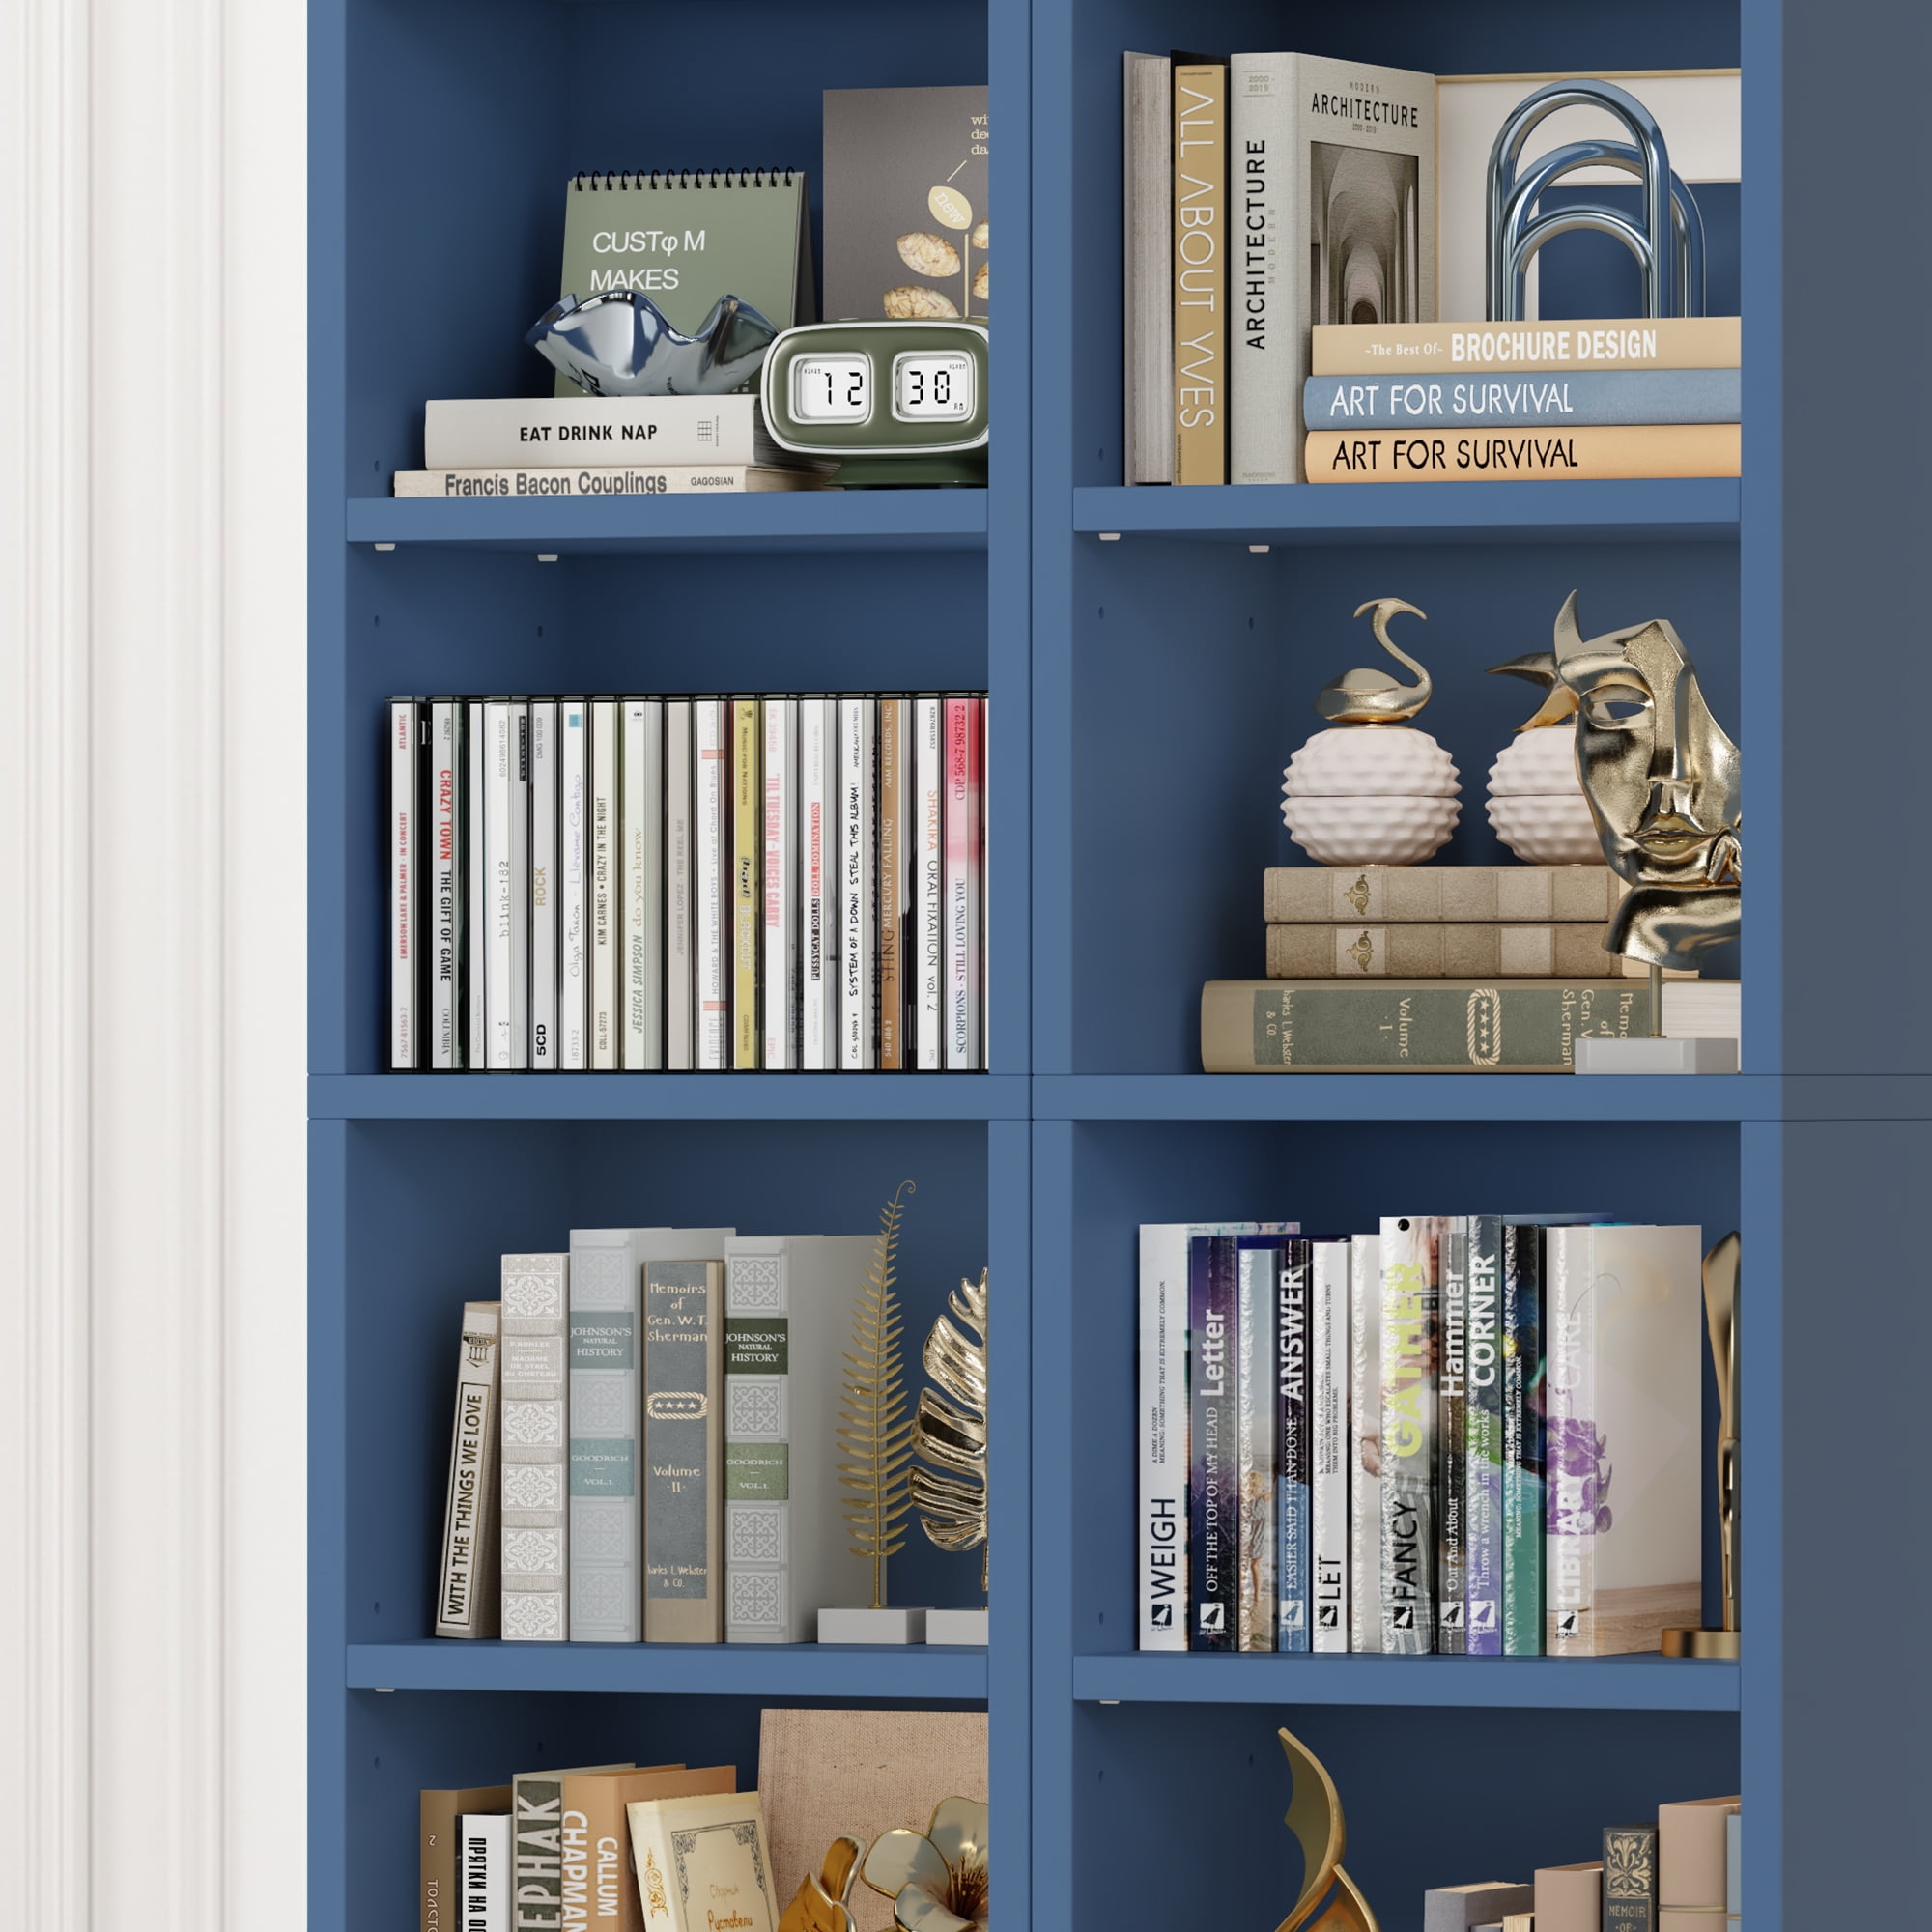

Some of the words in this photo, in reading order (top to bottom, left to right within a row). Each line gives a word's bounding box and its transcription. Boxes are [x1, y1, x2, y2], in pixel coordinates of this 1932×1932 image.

[1179, 86, 1215, 158] ALL
[1311, 92, 1419, 128] ARCHITECTURE
[934, 192, 966, 223] new
[1179, 173, 1215, 313] ABOUT
[1246, 140, 1266, 350] ARCHITECTURE
[1267, 209, 1276, 285] MODERN
[590, 268, 680, 291] MAKES
[1395, 342, 1420, 355] Best
[1451, 331, 1571, 361] BROCHURE
[1577, 329, 1657, 360] DESIGN
[824, 372, 863, 406] 12
[908, 370, 951, 405] 30
[1179, 330, 1215, 428] YVES
[1329, 385, 1379, 416] ART
[1390, 384, 1443, 416] FOR
[1452, 383, 1574, 415] SURVIVAL
[520, 427, 552, 441] EAT
[558, 425, 613, 440] DRINK
[621, 424, 658, 440] NAP
[1332, 440, 1381, 470] ART
[1393, 440, 1446, 469] FOR
[1456, 439, 1578, 469] SURVIVAL
[445, 473, 509, 496] Francis
[516, 472, 571, 496] Bacon
[578, 471, 667, 495] Couplings
[691, 477, 734, 487] GAGOSIAN
[954, 715, 966, 745] 98732
[709, 765, 718, 788] Blues
[954, 749, 966, 777] 568-7
[440, 770, 452, 814] CRAZY
[954, 778, 966, 801] CDP
[596, 797, 606, 821] NIGHT
[709, 806, 718, 834] Chord
[927, 790, 938, 850] SHAKIRA
[440, 821, 452, 861] TOWN
[596, 824, 606, 839] THE
[596, 843, 606, 852] IN
[811, 802, 820, 867] DOMINATION
[849, 824, 859, 848] THIS
[883, 819, 893, 867] FALLING
[399, 847, 407, 856] IN
[632, 828, 642, 870] know
[709, 845, 718, 865] Live
[440, 869, 451, 894] THE
[596, 855, 607, 882] CRAZY
[849, 851, 859, 885] STEAL
[927, 860, 938, 897] ORAL
[499, 861, 510, 937] blink-182
[535, 867, 546, 906] ROCK
[634, 875, 645, 902] you
[883, 872, 893, 929] MERCURY
[955, 878, 966, 903] YOU
[440, 897, 451, 923] GIFT
[597, 893, 607, 926] CARNES
[633, 907, 642, 927] do
[710, 901, 719, 927] WHITE
[766, 892, 780, 928] CARRY
[811, 898, 820, 929] DOLLS
[849, 893, 858, 924] DOWN
[440, 928, 451, 943] OF
[597, 928, 607, 945] KIM
[955, 905, 967, 947] LOVING
[811, 930, 820, 980] PUSSYCAT
[849, 937, 858, 950] OF
[881, 929, 895, 983] STING
[440, 948, 451, 981] GAME
[568, 945, 583, 977] Olga
[632, 934, 642, 986] SIMPSON
[711, 956, 720, 995] HOWARD
[849, 953, 858, 998] SYSTEM
[955, 950, 967, 982] STILL
[632, 989, 642, 1034] JESSICA
[955, 990, 967, 1054] SCORPIONS
[1580, 988, 1595, 1027] Gen.
[536, 1024, 547, 1056] 5CD
[1399, 997, 1413, 1058] Volume
[1561, 988, 1577, 1065] Sherman
[1599, 1020, 1615, 1039] of
[767, 1037, 776, 1060] EPIC
[649, 1283, 706, 1294] Memoirs
[670, 1296, 686, 1311] of
[570, 1327, 632, 1339] JOHNSON'S
[647, 1315, 676, 1326] Gen.
[647, 1329, 708, 1342] Sherman
[1280, 1267, 1304, 1402] ANSWER
[1440, 1268, 1464, 1398] Hammer
[1469, 1253, 1496, 1387] CORNER
[577, 1348, 624, 1356] HISTORY
[724, 1333, 786, 1344] JOHNSON'S
[1200, 1308, 1225, 1396] Letter
[731, 1353, 779, 1362] HISTORY
[1384, 1262, 1423, 1458] GATHER
[464, 1395, 482, 1437] LOVE
[1206, 1407, 1218, 1449] HEAD
[1477, 1408, 1491, 1447] works
[460, 1440, 478, 1466] WE
[1286, 1416, 1297, 1459] DONE
[653, 1464, 701, 1477] Volume
[1206, 1453, 1218, 1474] MY
[1478, 1449, 1491, 1470] the
[1206, 1476, 1217, 1496] OF
[1286, 1462, 1297, 1503] THAN
[1478, 1472, 1491, 1486] in
[455, 1470, 475, 1532] THINGS
[1206, 1499, 1218, 1530] TOP
[1446, 1497, 1459, 1536] About
[1478, 1488, 1491, 1534] wrench
[1286, 1506, 1297, 1540] SAID
[1557, 1467, 1581, 1605] LIBRARY
[451, 1536, 469, 1568] THE
[1151, 1499, 1176, 1600] WEIGH
[1206, 1532, 1218, 1562] THE
[1392, 1500, 1418, 1601] FANCY
[1446, 1537, 1459, 1563] And
[1206, 1563, 1218, 1592] OFF
[1286, 1541, 1297, 1590] EASIER
[1318, 1553, 1341, 1600] LET
[1446, 1566, 1459, 1591] Out
[1478, 1547, 1491, 1588] Throw
[447, 1572, 467, 1617] WITH
[469, 1837, 487, 1889] ПРЯТКИ
[517, 1794, 561, 1929] ЕРНАК
[597, 1836, 619, 1916] CALLUM
[469, 1895, 487, 1913] НА
[1608, 1905, 1647, 1918] MEMOIR
